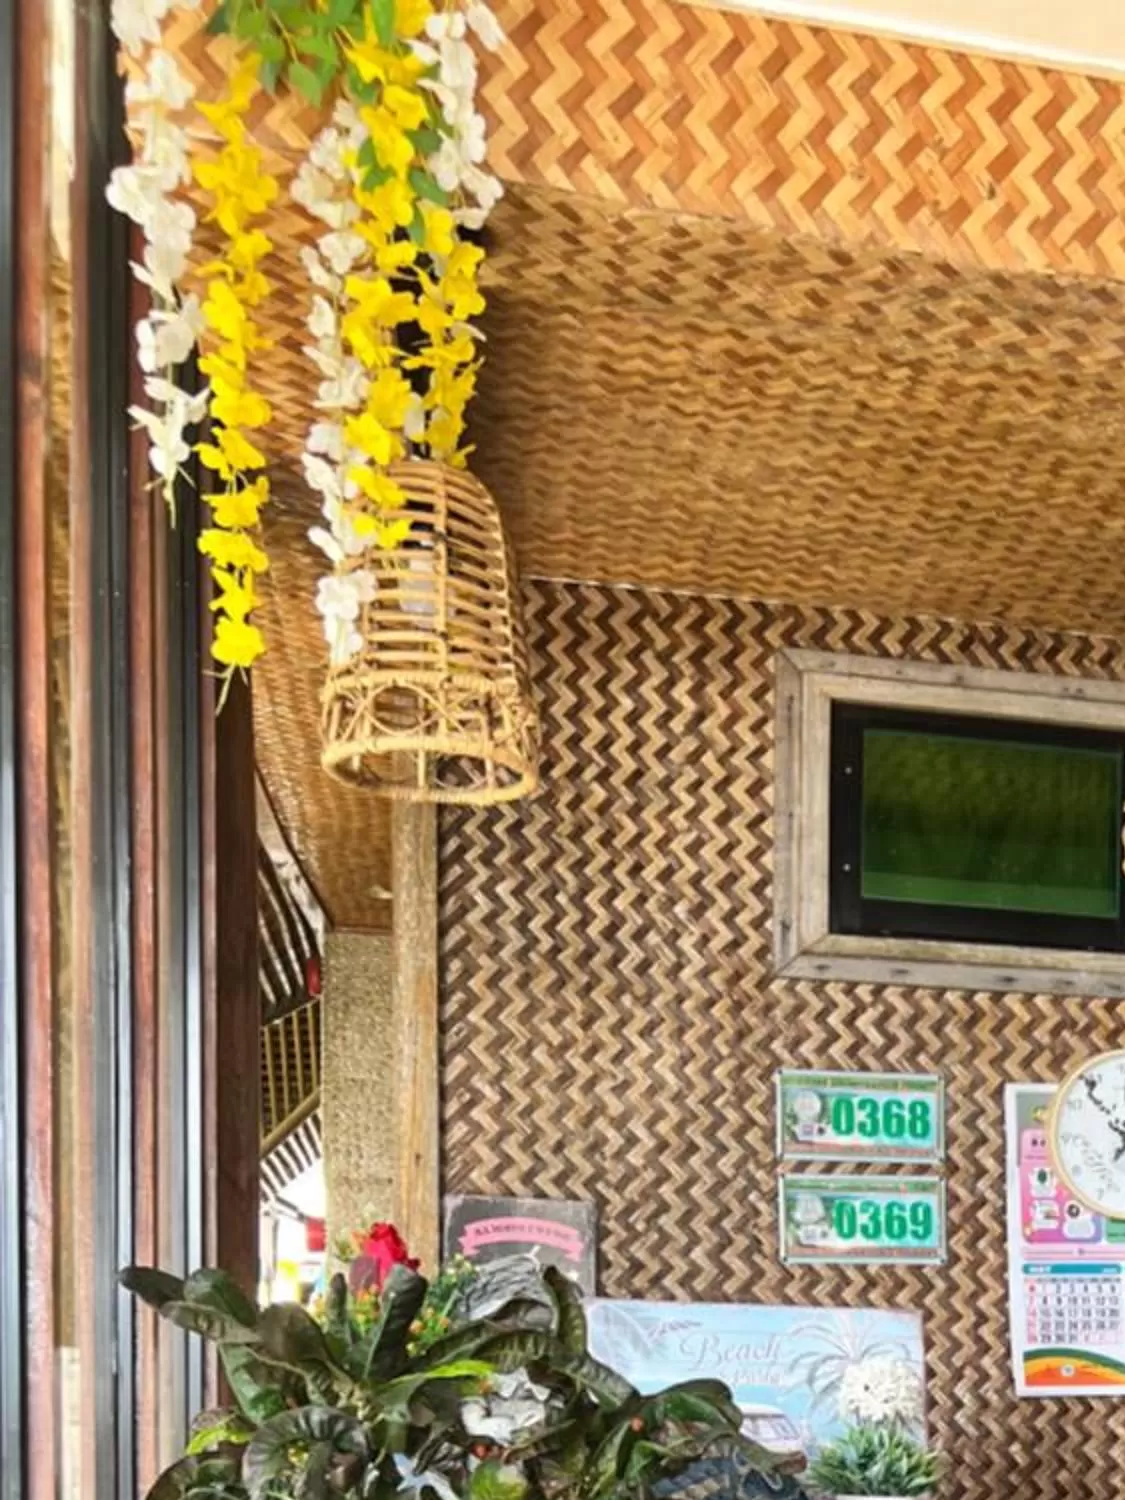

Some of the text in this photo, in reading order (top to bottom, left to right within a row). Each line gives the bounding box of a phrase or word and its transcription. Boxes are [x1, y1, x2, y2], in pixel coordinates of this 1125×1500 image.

[832, 1096, 930, 1139] 0368
[834, 1199, 932, 1240] 0369
[679, 1331, 783, 1371] Beach
